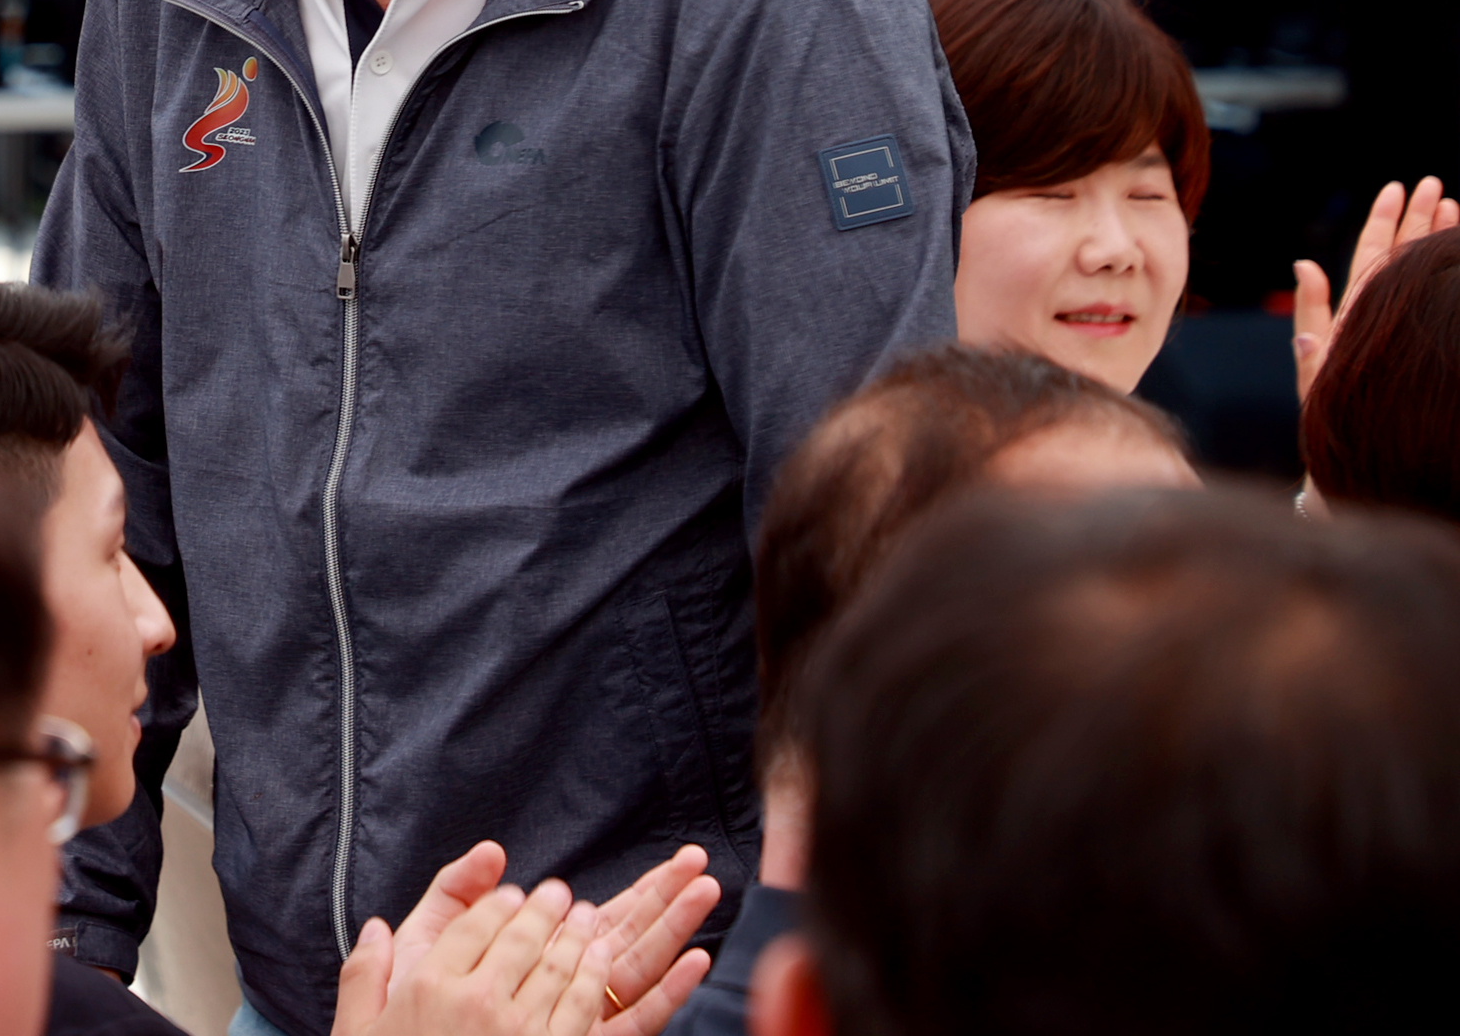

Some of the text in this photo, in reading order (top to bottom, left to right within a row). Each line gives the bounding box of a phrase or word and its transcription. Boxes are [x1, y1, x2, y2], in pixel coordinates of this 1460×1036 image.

[832, 172, 878, 189] BEYOND
[842, 175, 899, 194] YOUR LIMIT
